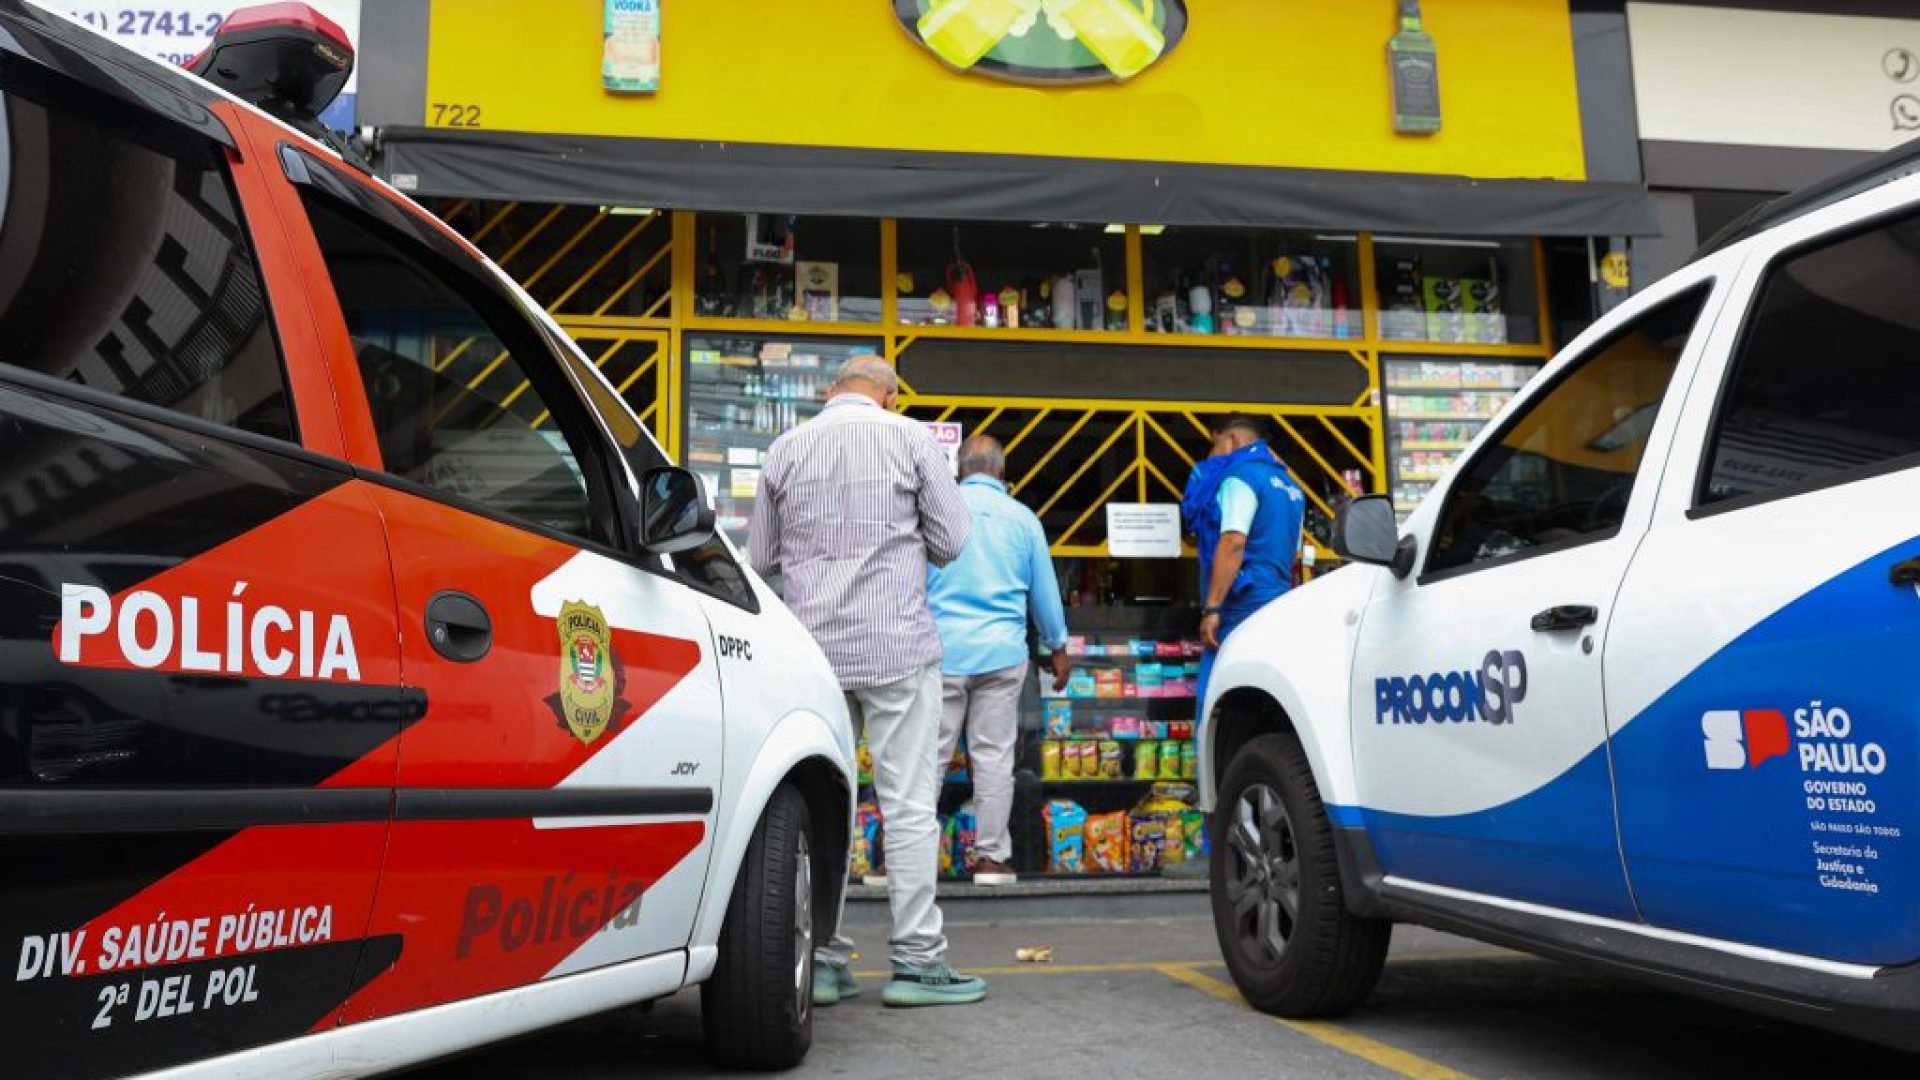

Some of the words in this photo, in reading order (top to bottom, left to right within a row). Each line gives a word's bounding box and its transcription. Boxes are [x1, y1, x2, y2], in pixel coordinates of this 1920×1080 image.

[432, 103, 480, 126] 722
[59, 581, 361, 681] POLÍCIA
[719, 635, 752, 661] DPPC
[1794, 700, 1851, 738] SÃO
[671, 762, 700, 776] JOY
[1798, 742, 1886, 775] PAULO
[1804, 779, 1866, 796] GOVERNO
[1807, 796, 1825, 810] DO
[1828, 798, 1876, 813] ESTADO
[1812, 841, 1863, 859] Secretaria
[1864, 845, 1878, 859] da
[1816, 858, 1854, 876] Justiça
[1855, 865, 1864, 874] e
[1819, 875, 1878, 893] Cidadania
[455, 872, 644, 961] Polícia
[16, 931, 87, 981] DIV.
[98, 911, 210, 971] SAÚDE
[215, 903, 333, 955] PÚBLICA
[135, 974, 195, 1022] DEL
[203, 964, 259, 1010] POL
